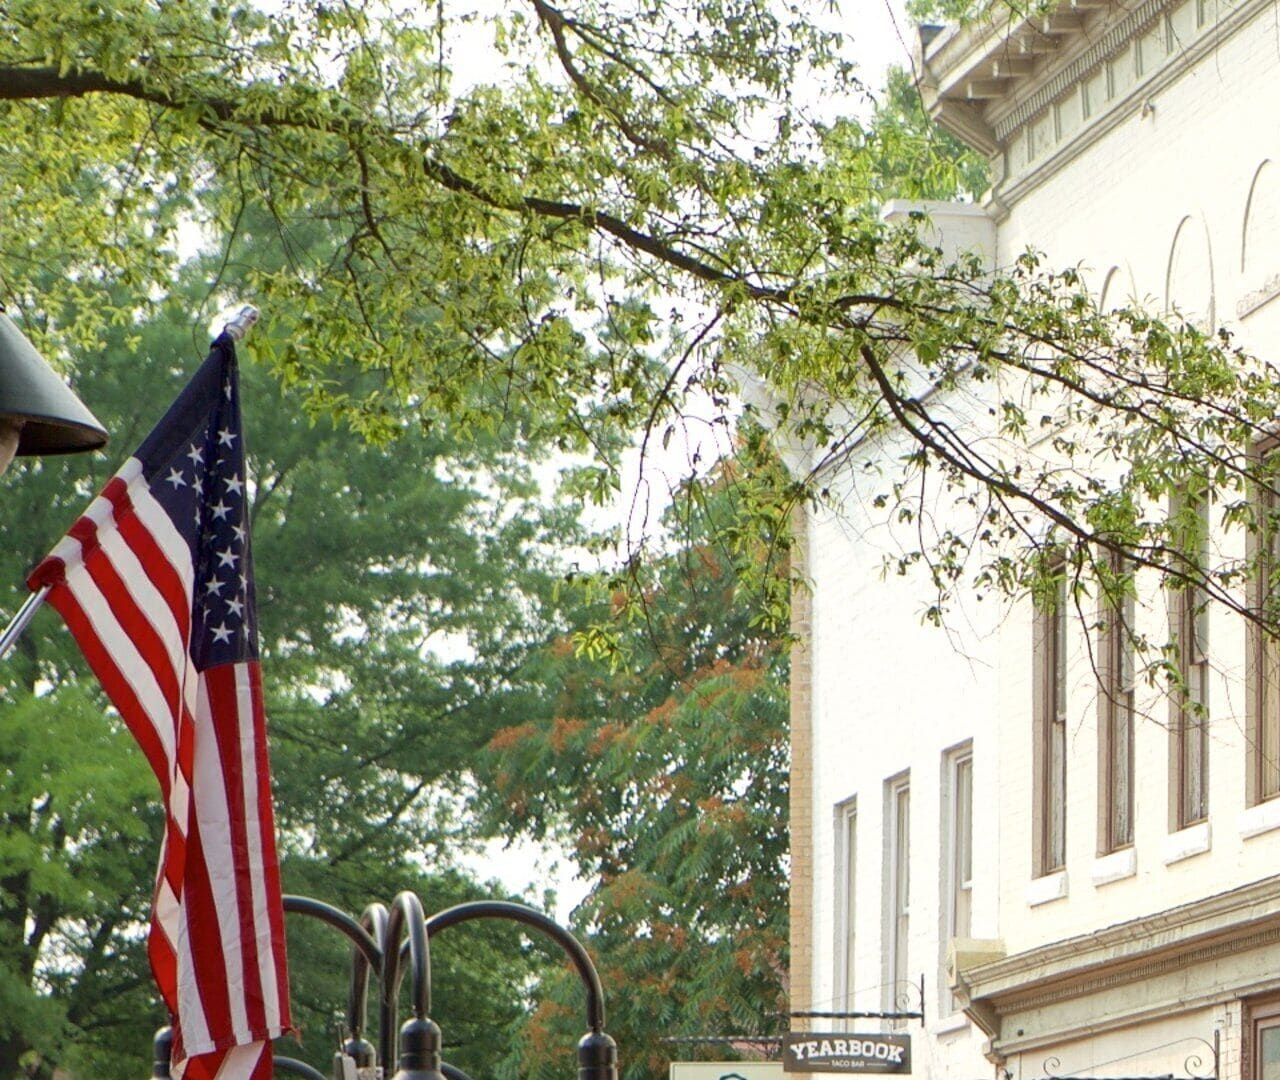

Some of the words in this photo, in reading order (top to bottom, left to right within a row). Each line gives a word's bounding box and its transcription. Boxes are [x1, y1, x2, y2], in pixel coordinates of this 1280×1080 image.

[789, 1038, 904, 1063] YEARBOOK
[831, 1059, 849, 1068] TACO
[851, 1060, 865, 1068] BAR
